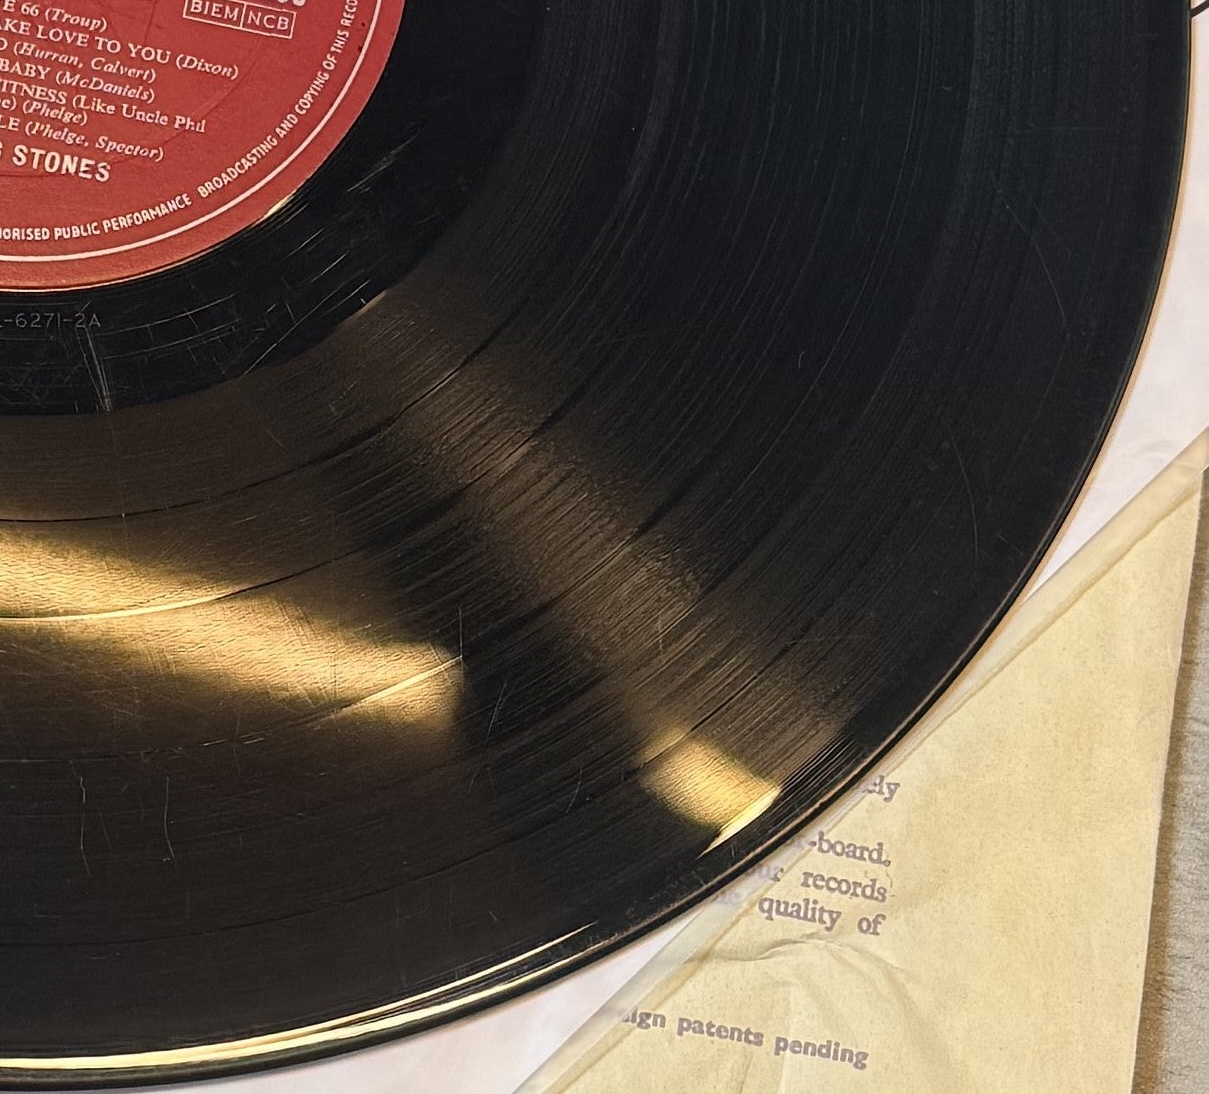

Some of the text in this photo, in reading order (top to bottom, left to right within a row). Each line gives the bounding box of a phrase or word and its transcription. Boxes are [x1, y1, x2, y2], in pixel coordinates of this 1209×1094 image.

[21, 2, 40, 17] 66
[44, 6, 108, 33] (Troup)
[247, 11, 290, 32] NCB
[36, 26, 90, 47] LOVE
[94, 36, 121, 54] TO
[127, 43, 171, 64] YOU
[175, 54, 239, 80] (Dixon)
[330, 29, 350, 55] THIS
[90, 57, 157, 84] Calvert)
[323, 53, 338, 71] OF
[55, 70, 155, 104] (McDaniels)
[294, 70, 330, 117] COPYING
[22, 100, 88, 126] (Phelge)
[72, 94, 116, 115] (Like
[121, 104, 169, 126] Uncle
[276, 113, 299, 139] AND
[12, 144, 111, 182] STONES
[95, 135, 164, 162] Spector)
[196, 134, 278, 199] BROADCASTING
[53, 221, 101, 241] PUBLIC
[103, 193, 192, 233] PERFORMANCE
[801, 871, 887, 903] records
[758, 897, 886, 936] quality of
[677, 1017, 764, 1047] patents
[774, 1035, 869, 1070] pending
